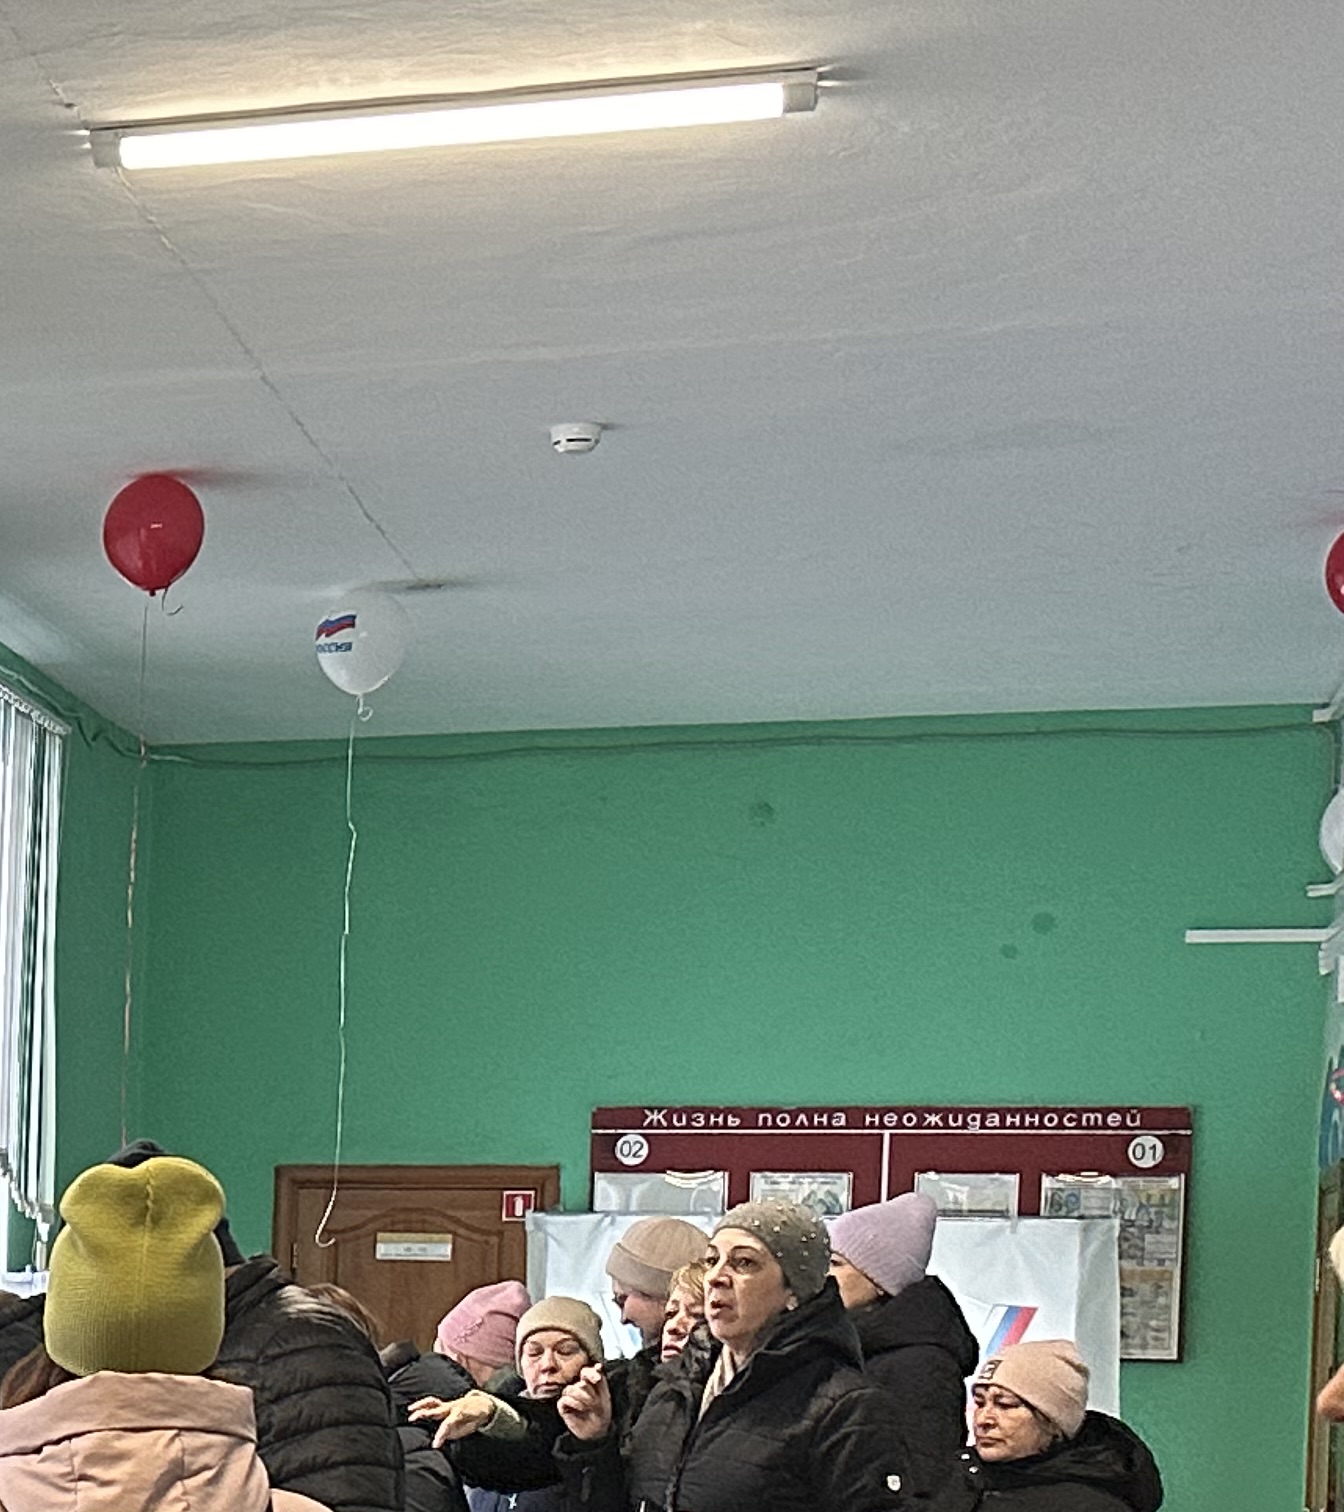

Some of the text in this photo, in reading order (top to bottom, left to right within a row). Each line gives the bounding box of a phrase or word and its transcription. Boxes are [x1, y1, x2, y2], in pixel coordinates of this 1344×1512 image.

[643, 1109, 1142, 1131] Жизнь полна неожиданностей
[619, 1140, 644, 1159] 02
[1132, 1143, 1159, 1161] 01
